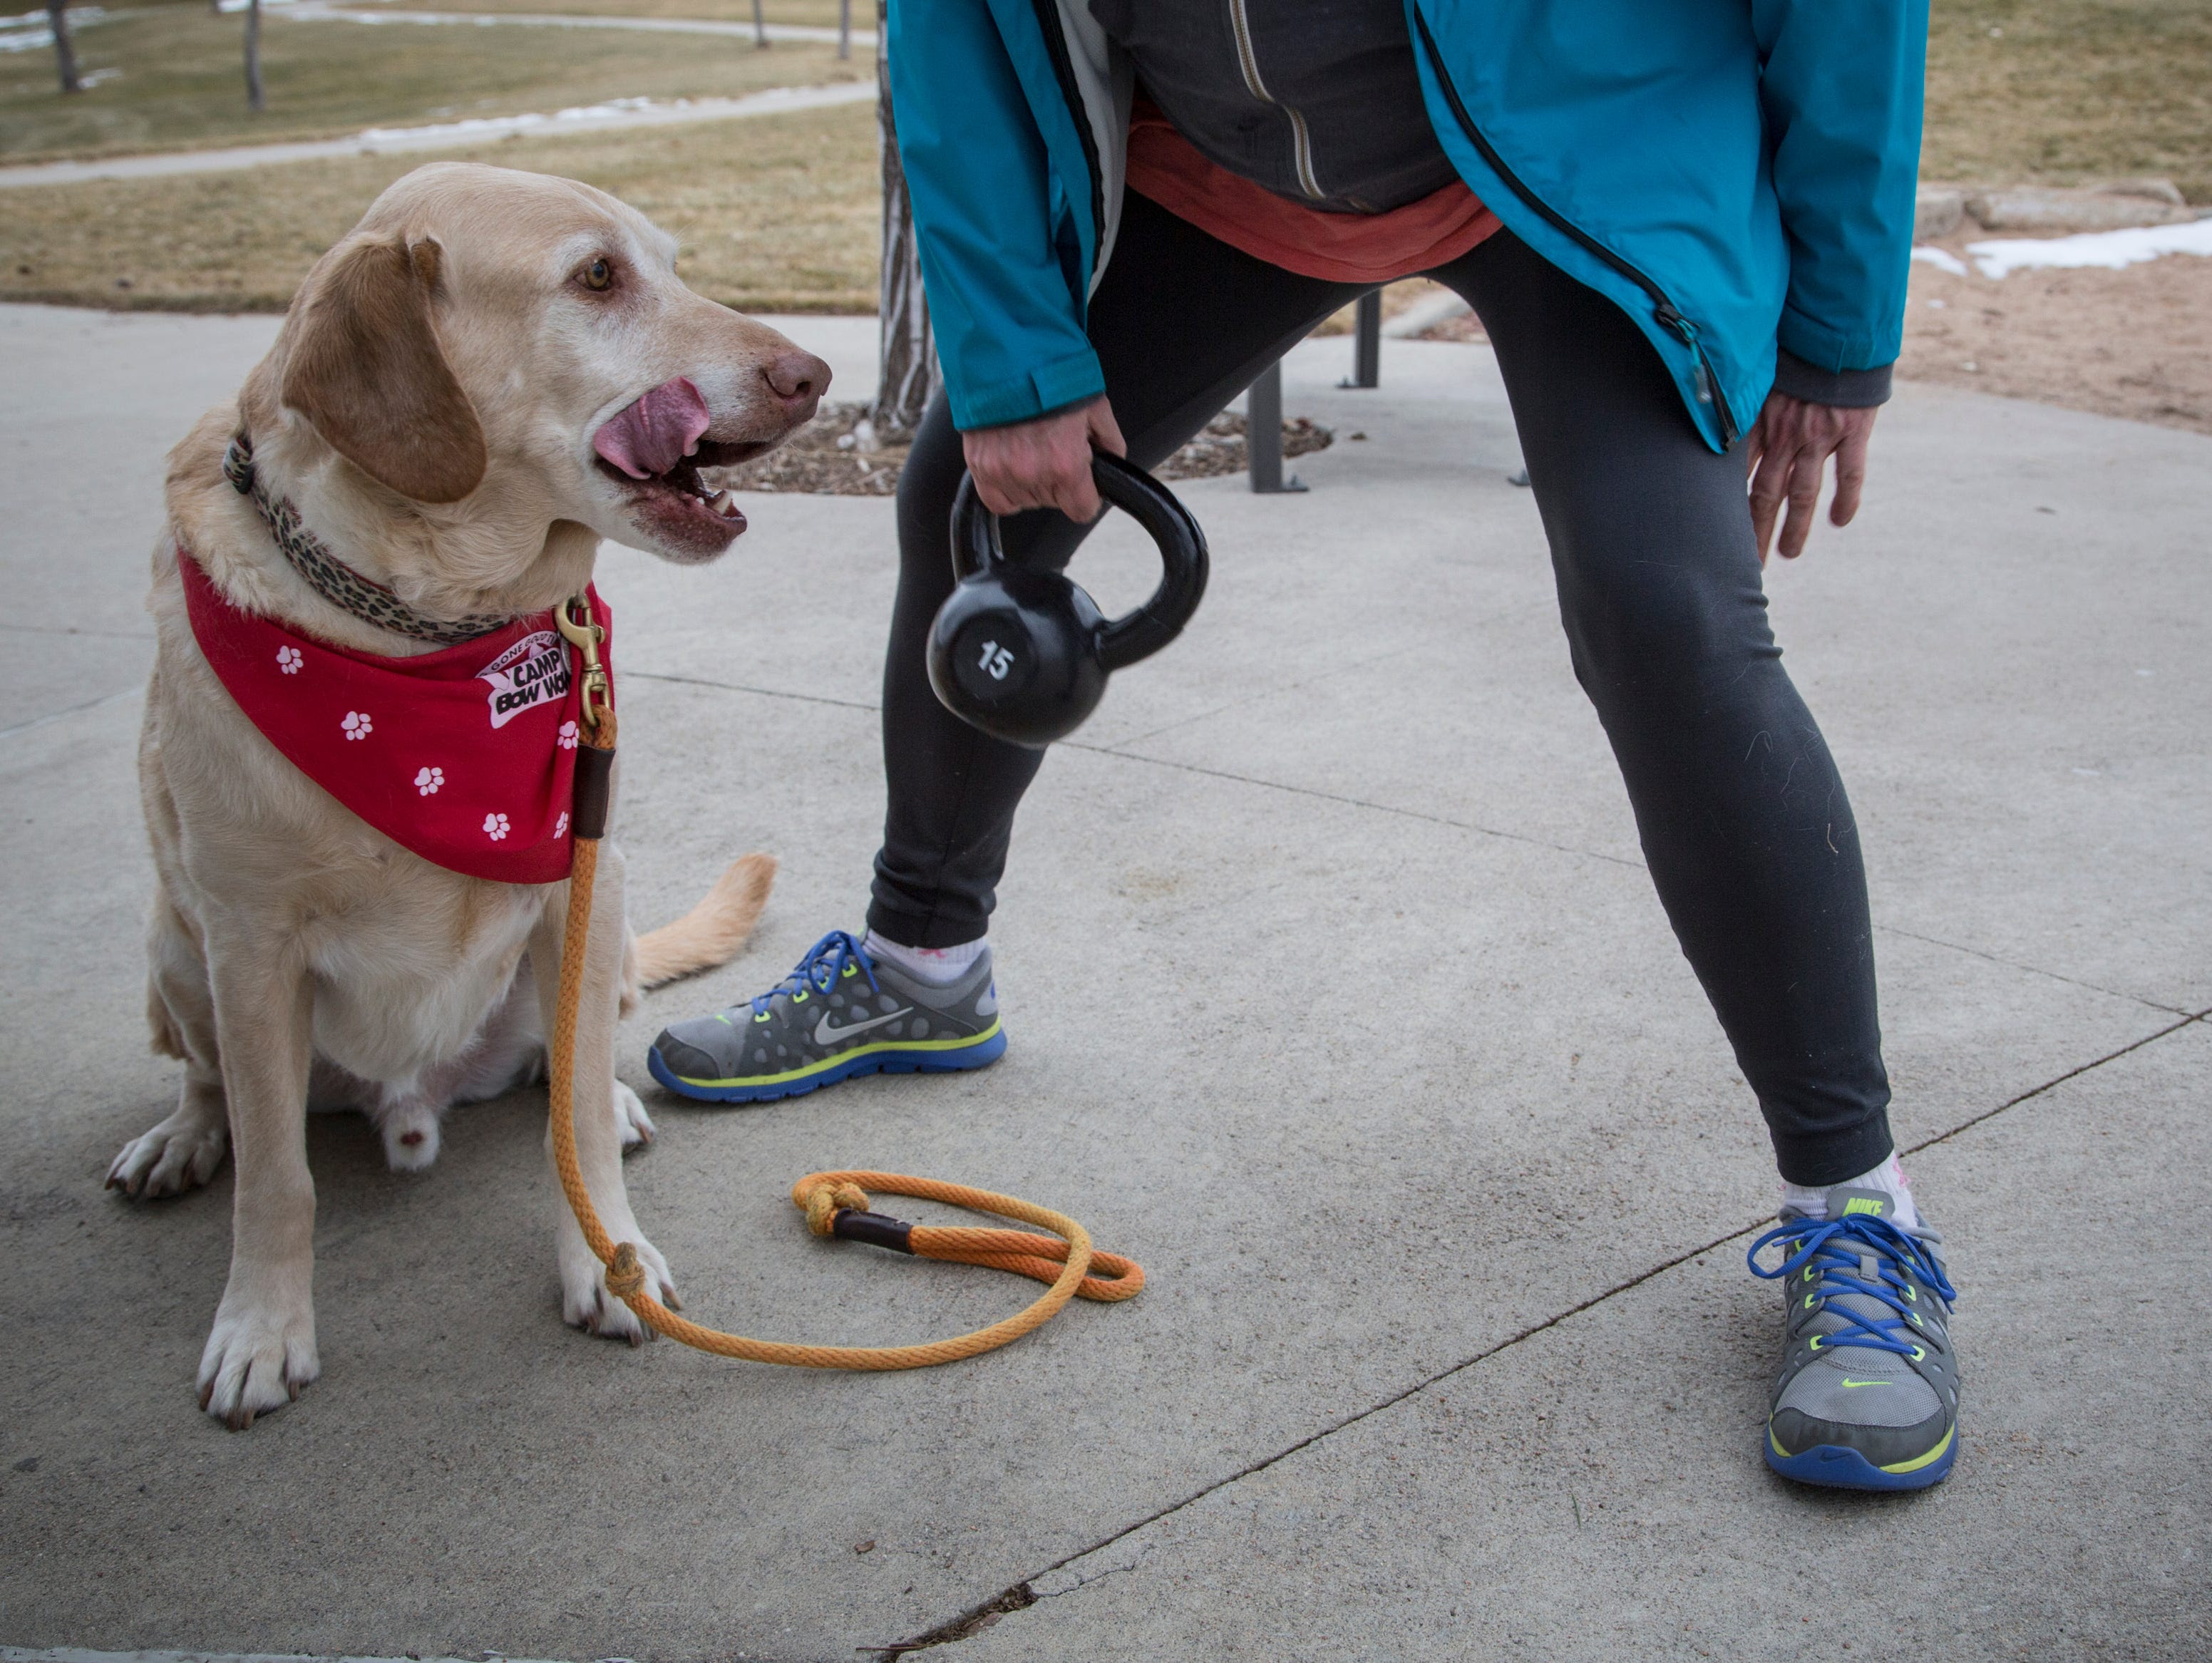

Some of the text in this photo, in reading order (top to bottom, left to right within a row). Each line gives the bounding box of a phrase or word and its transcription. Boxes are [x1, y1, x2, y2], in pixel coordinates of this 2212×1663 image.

[491, 644, 523, 670] GONE
[514, 650, 560, 687] CAMP
[978, 640, 1015, 680] 15
[496, 682, 540, 715] BOW
[1842, 1198, 1883, 1217] NIKE
